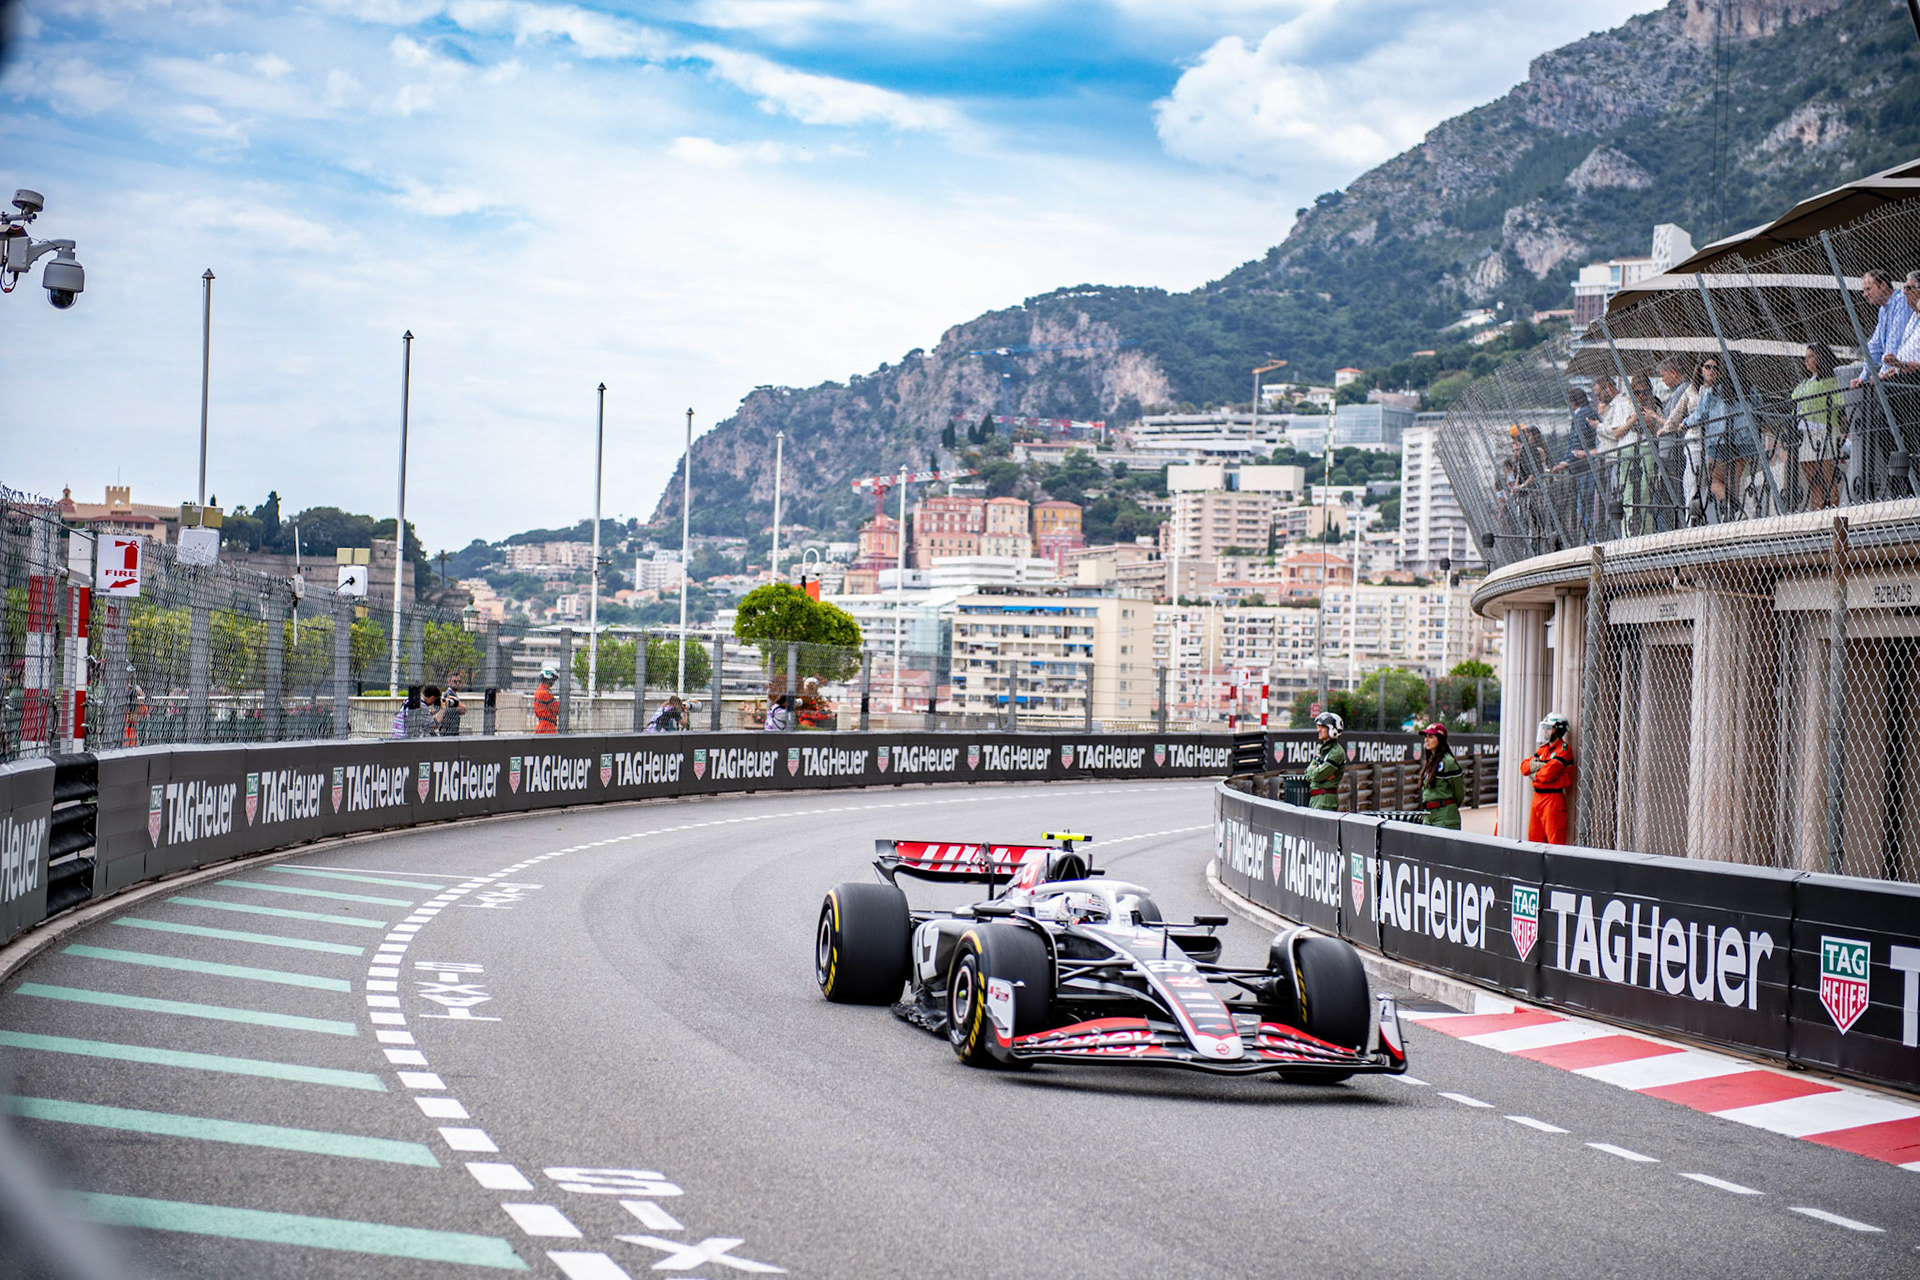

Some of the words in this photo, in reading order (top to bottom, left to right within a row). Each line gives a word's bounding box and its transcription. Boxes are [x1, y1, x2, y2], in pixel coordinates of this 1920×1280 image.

[615, 751, 684, 786] TAGHeuer
[709, 748, 779, 780] TAGHeuer
[802, 747, 869, 776] TAGHeuer
[892, 746, 959, 773] TAGHeuer
[983, 745, 1051, 770] TAGHeuer
[1076, 744, 1145, 769] TAGHeuer
[1168, 744, 1231, 768] TAGHeuer
[1286, 741, 1320, 763] TAGH
[1358, 742, 1407, 762] TAGHeuer
[346, 764, 410, 812] TAGHeuer
[433, 760, 501, 802] TAGHeuer
[524, 755, 592, 792] TAGHeuer
[166, 780, 237, 845] TAGHeuer
[261, 770, 325, 824] TAGHeuer
[0, 817, 46, 905] Heuer
[1283, 834, 1346, 908] TAGHeuer
[1366, 857, 1495, 949] TAGHeuer
[1514, 890, 1536, 916] TAG
[1513, 919, 1536, 953] HEUER
[1550, 890, 1775, 1011] TAGHeuer
[1143, 959, 1194, 973] 27
[1825, 943, 1865, 976] TAG
[1823, 979, 1866, 1026] HEUER
